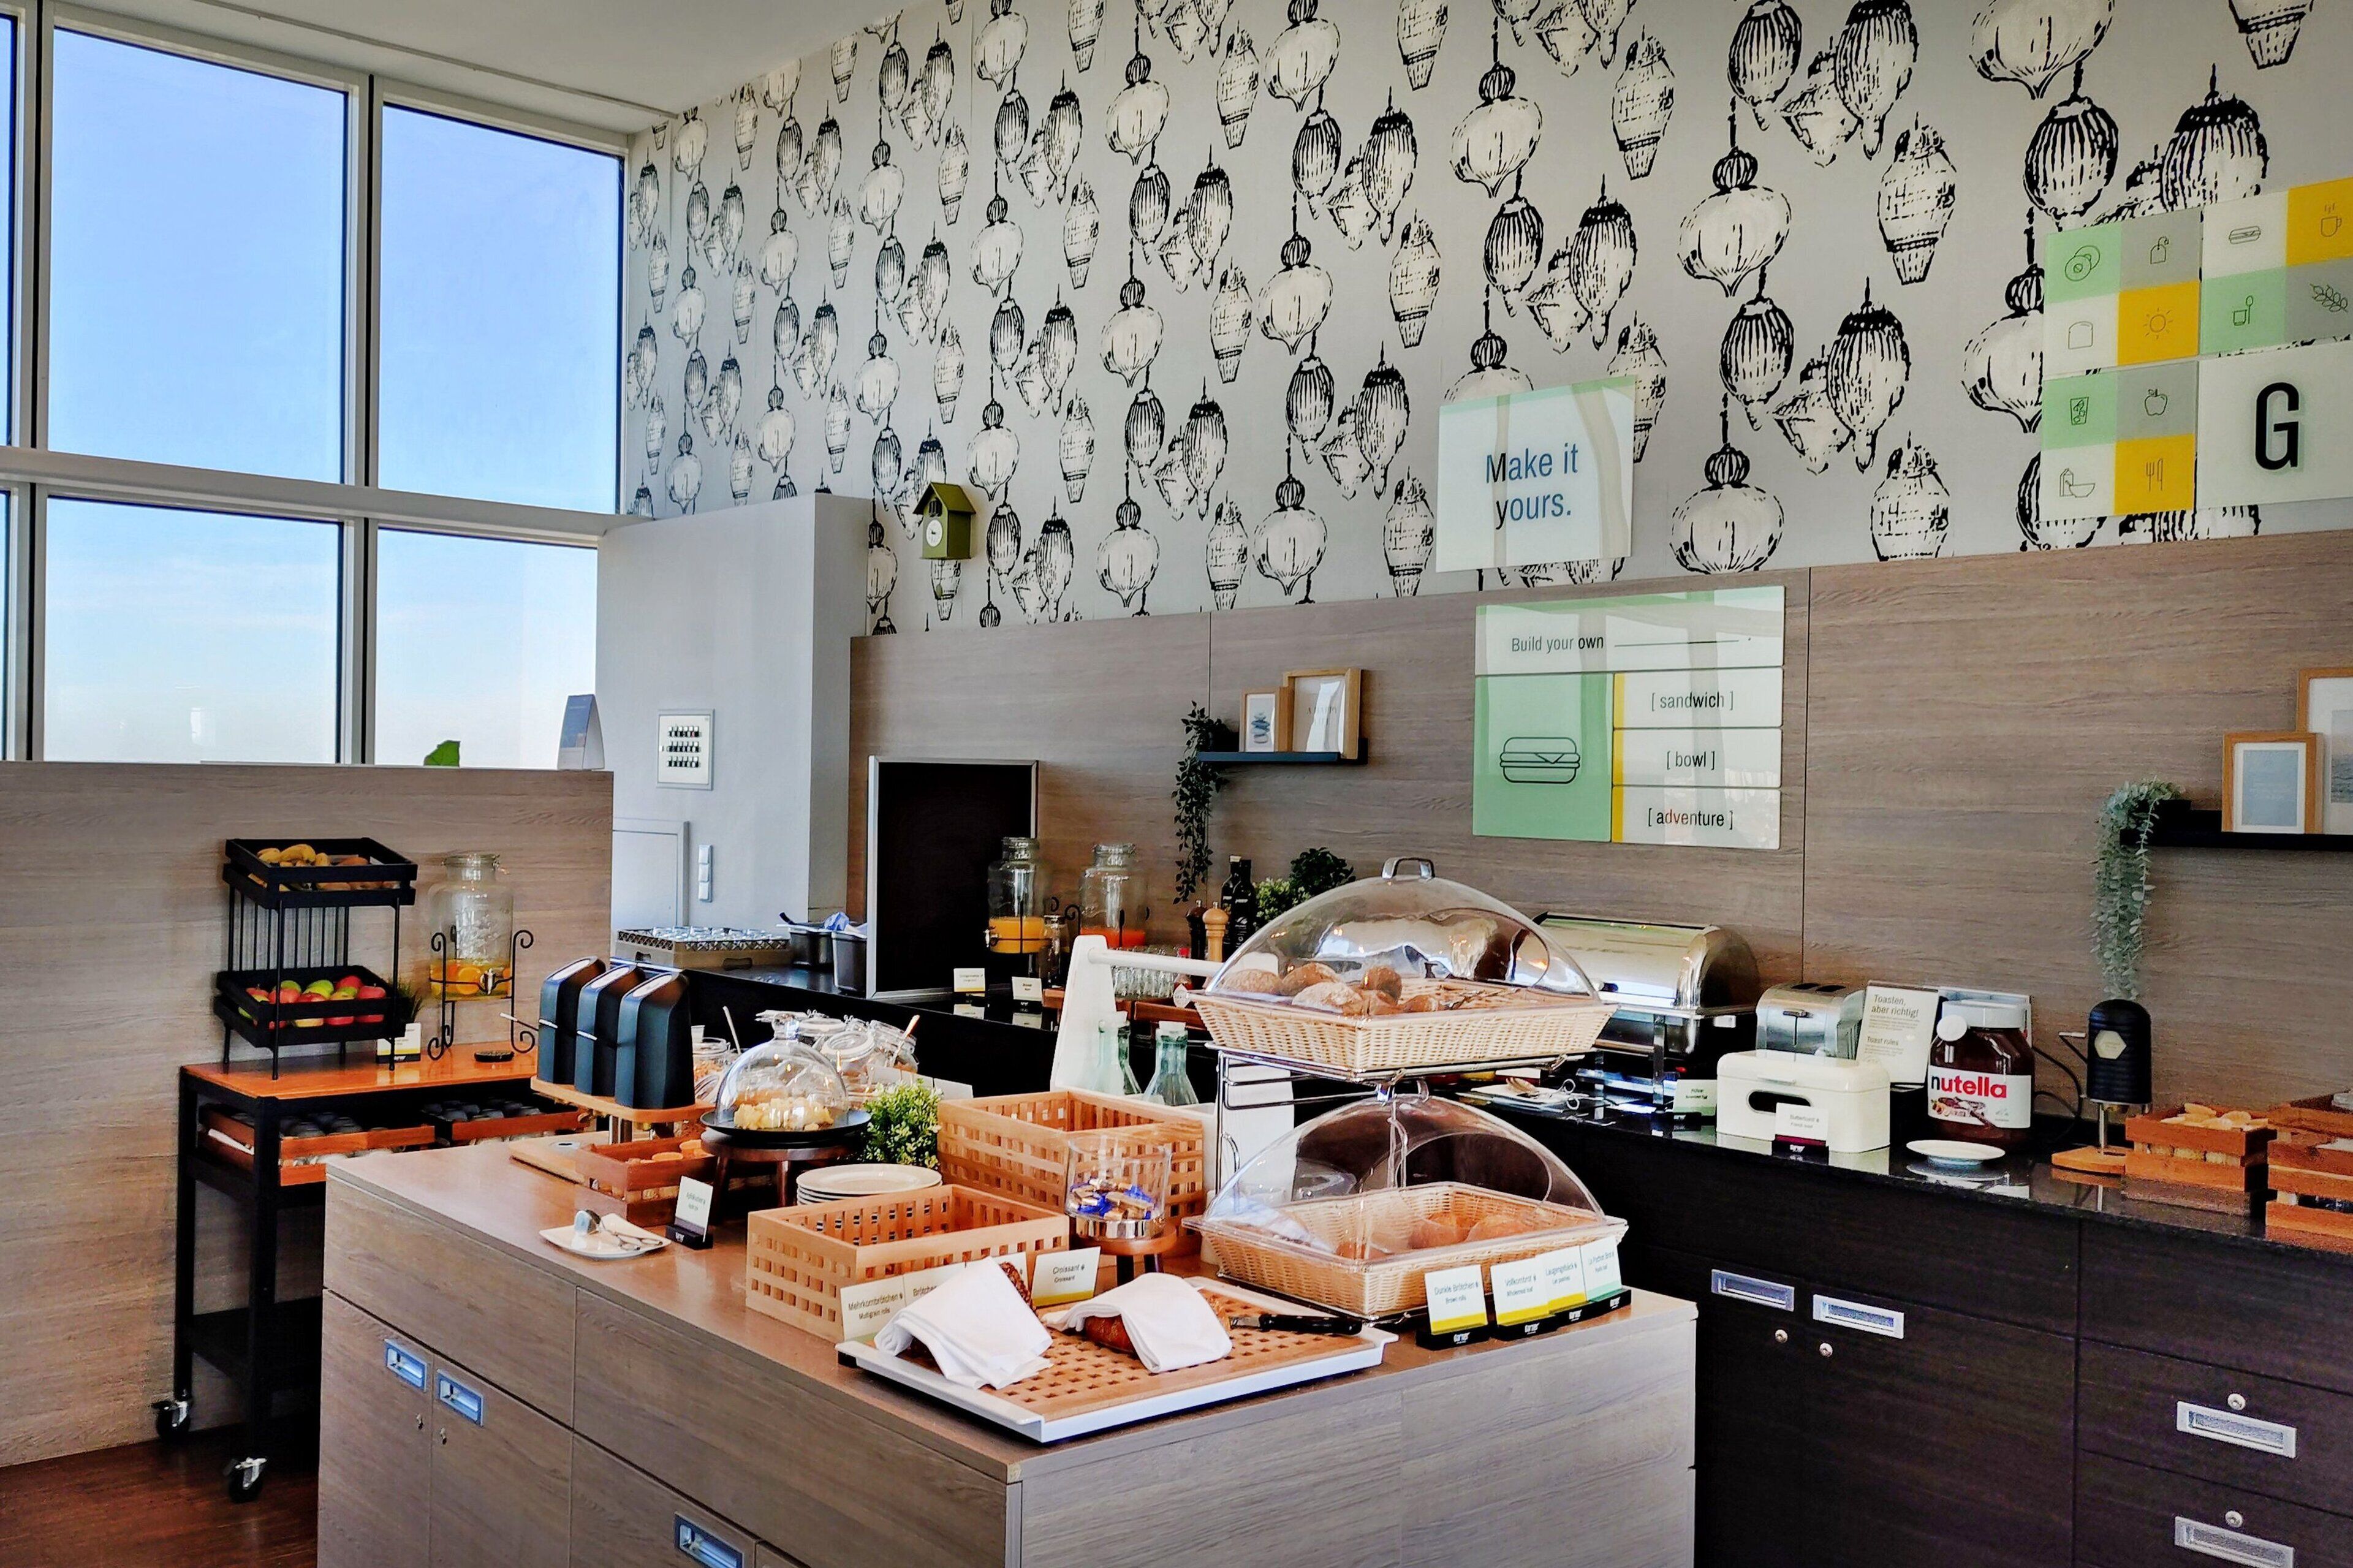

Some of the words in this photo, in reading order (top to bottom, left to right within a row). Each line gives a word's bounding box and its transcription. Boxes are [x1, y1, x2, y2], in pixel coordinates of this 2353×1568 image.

[2254, 381, 2300, 471] G
[1486, 447, 1553, 483] Make
[1564, 442, 1578, 474] it
[1495, 493, 1571, 531] yours.
[1512, 636, 1542, 652] Build
[1546, 638, 1574, 654] your
[1578, 636, 1604, 650] own
[1871, 1005, 1889, 1014] aber
[1931, 1075, 2007, 1099] nutella
[1052, 1263, 1080, 1275] Croissant
